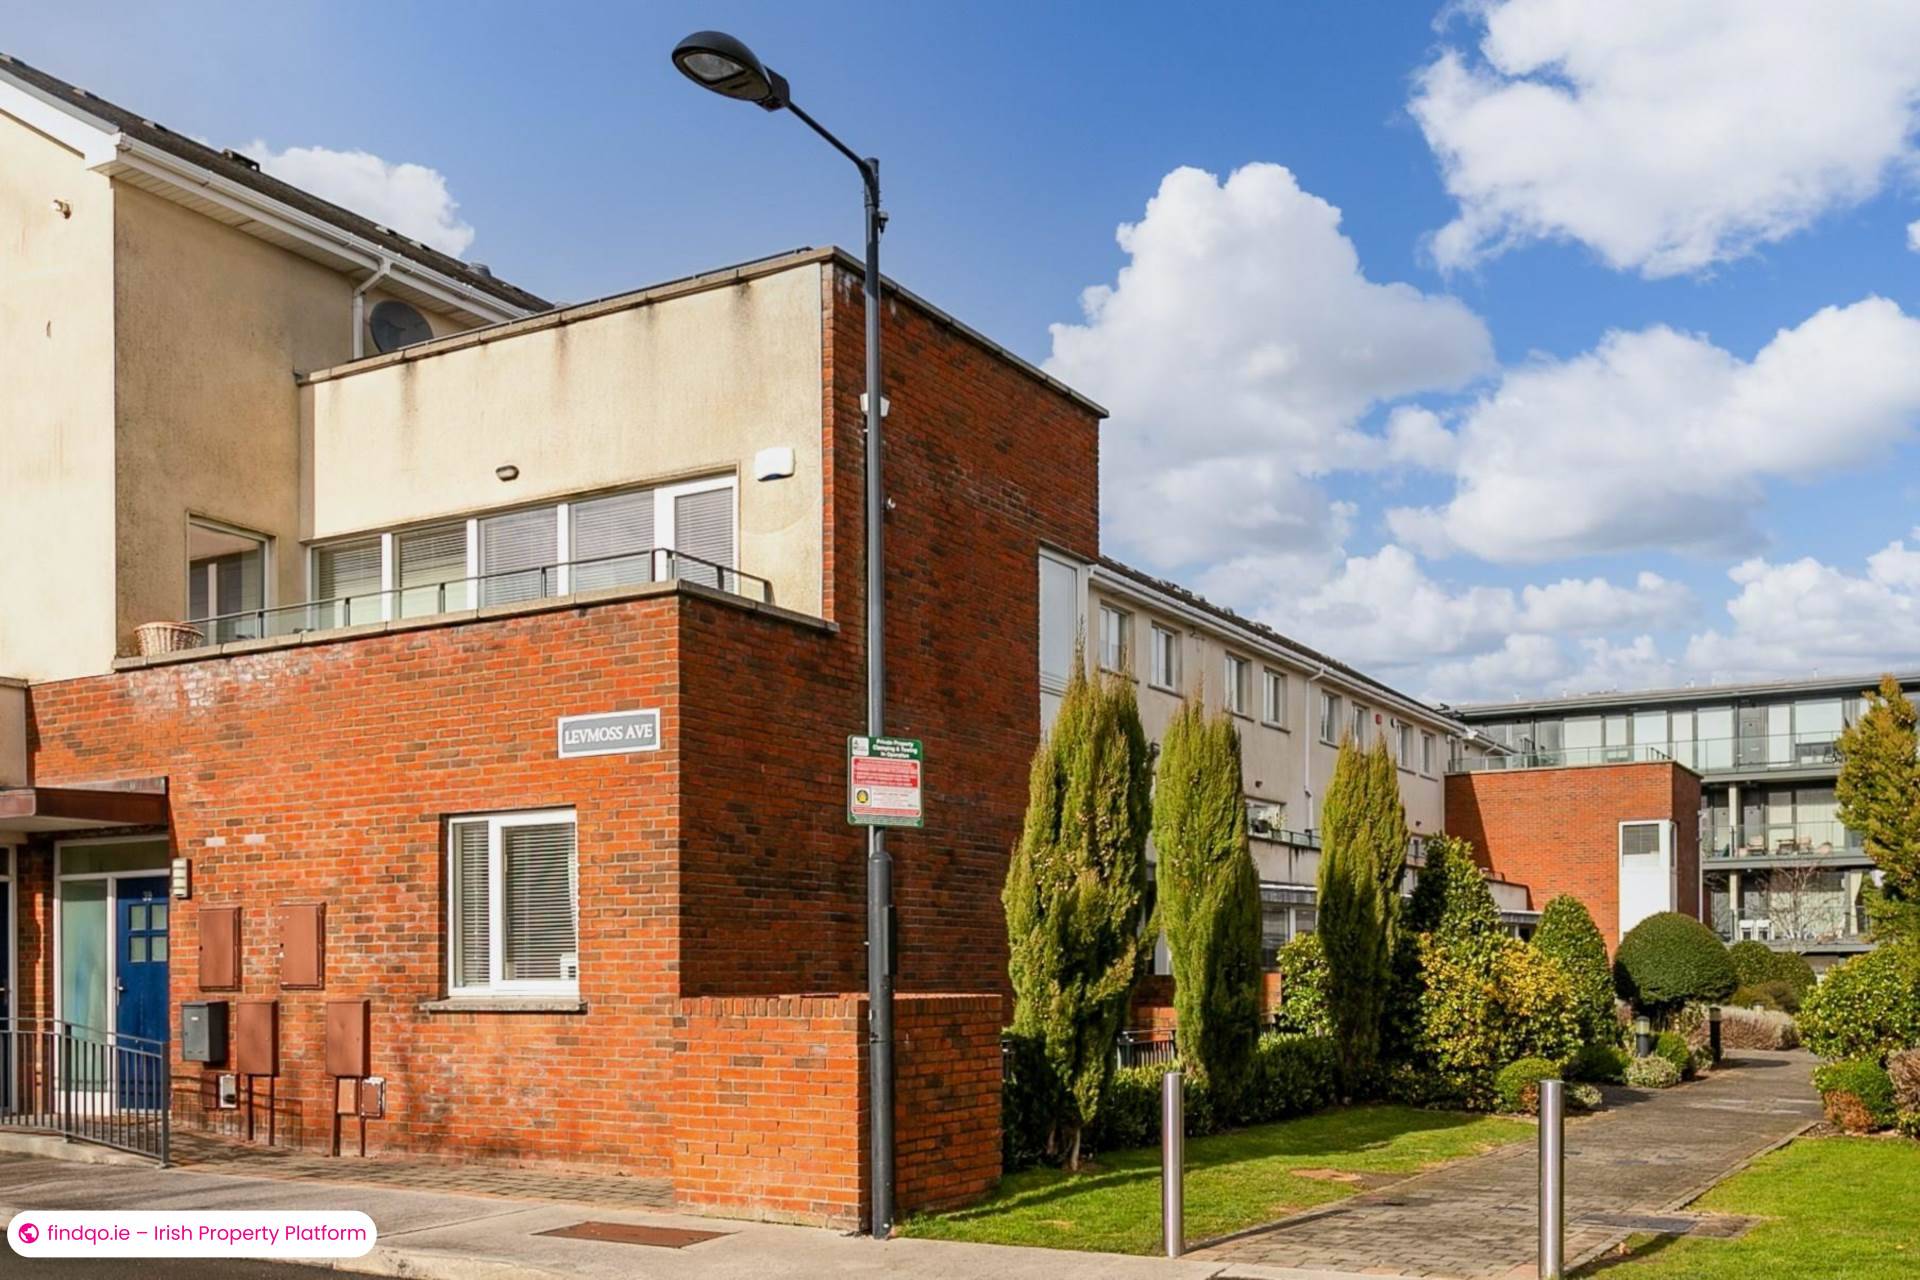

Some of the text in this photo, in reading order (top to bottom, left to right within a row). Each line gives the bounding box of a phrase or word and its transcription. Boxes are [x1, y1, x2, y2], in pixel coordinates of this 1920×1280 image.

[565, 723, 653, 744] LEVMOSS AVE
[872, 744, 896, 753] Clamping
[894, 740, 914, 748] Property
